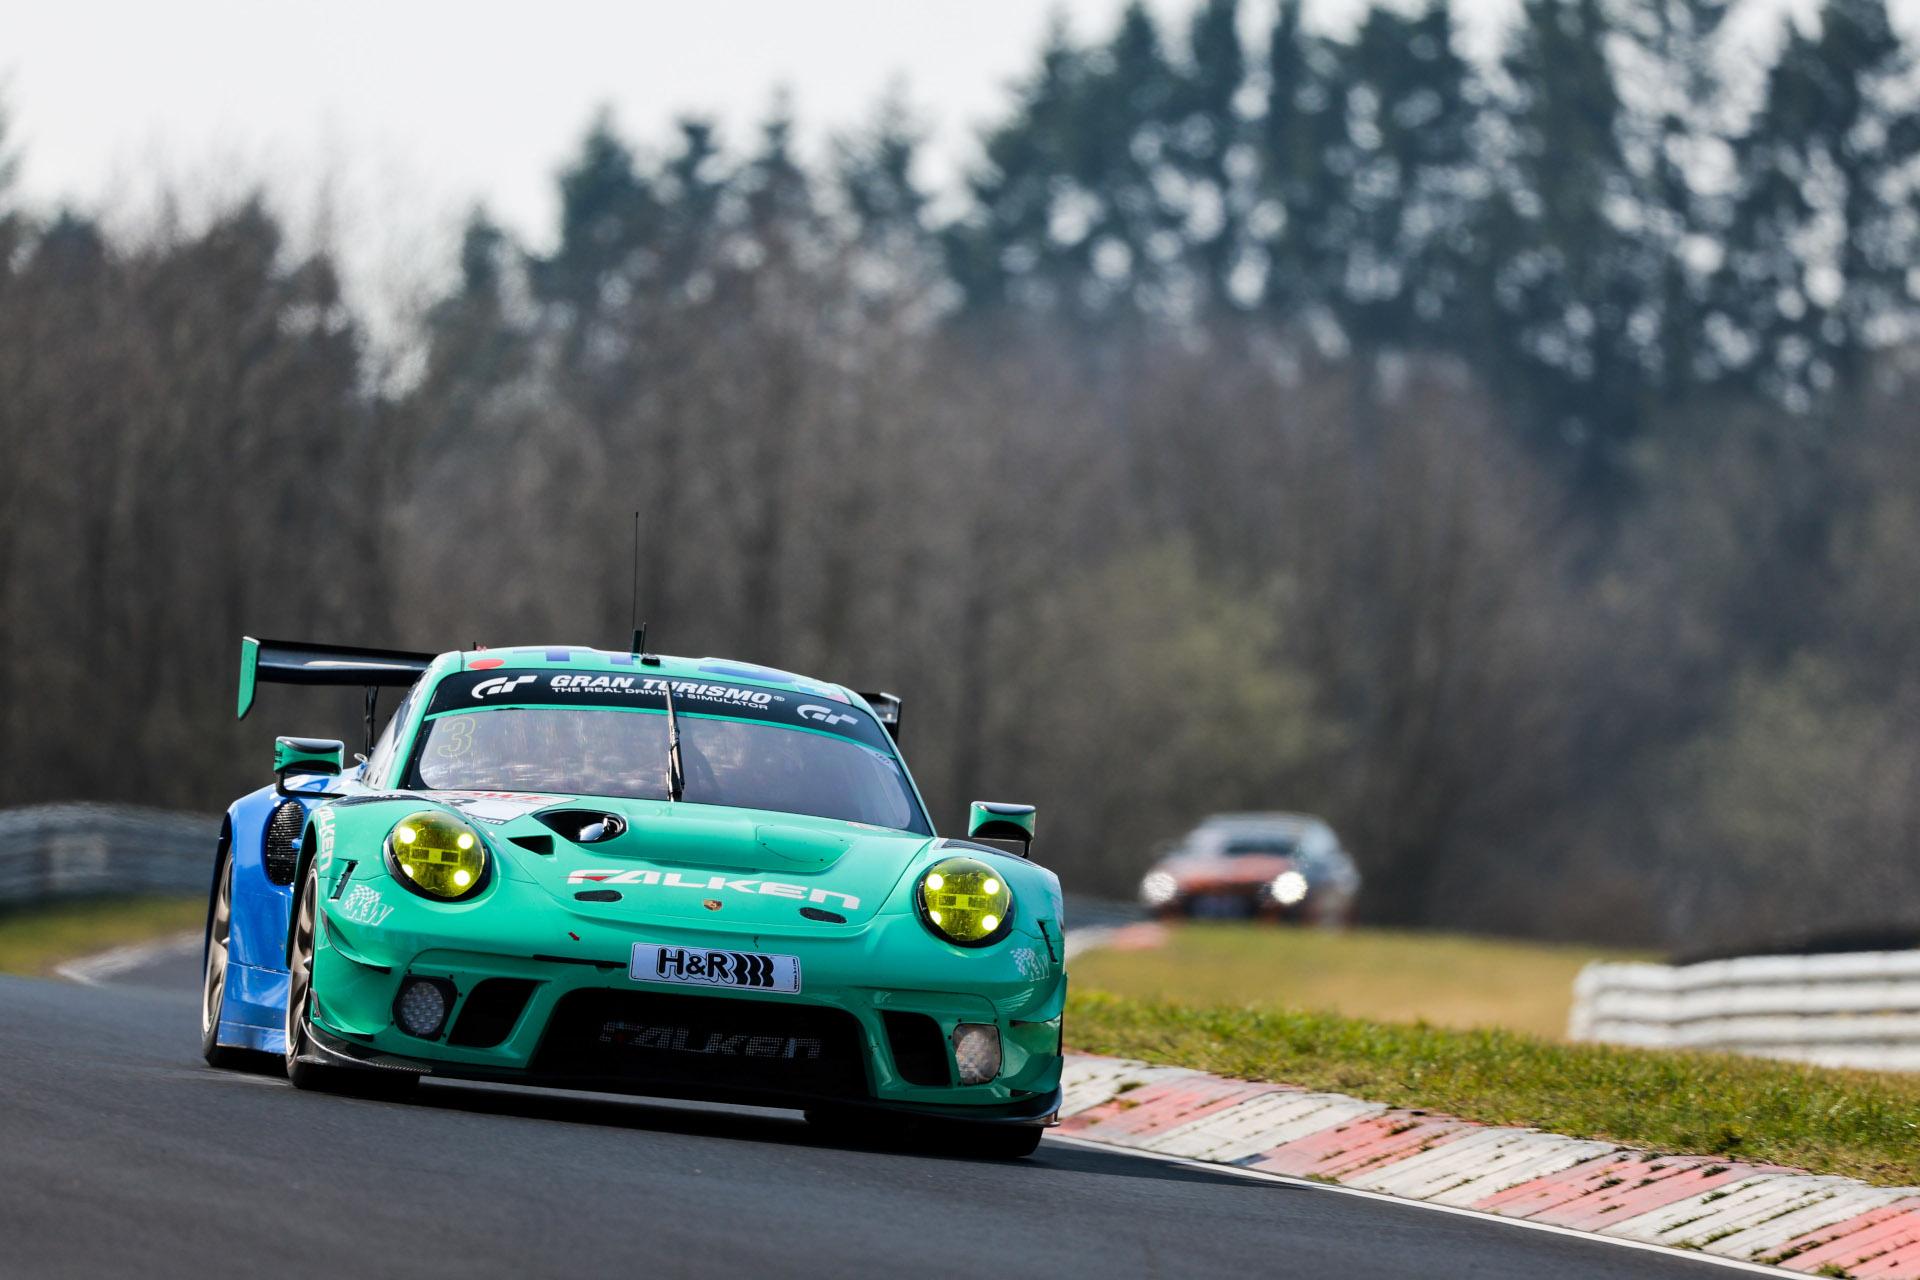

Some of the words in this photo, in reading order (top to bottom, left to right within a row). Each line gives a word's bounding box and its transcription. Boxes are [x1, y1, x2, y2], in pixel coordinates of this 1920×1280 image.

[550, 674, 635, 688] GRAN
[687, 693, 769, 711] SIMULATOR
[437, 716, 477, 758] 3
[567, 869, 861, 910] FALKEN
[656, 947, 733, 982] H&R
[600, 1021, 823, 1060] FALKEN
